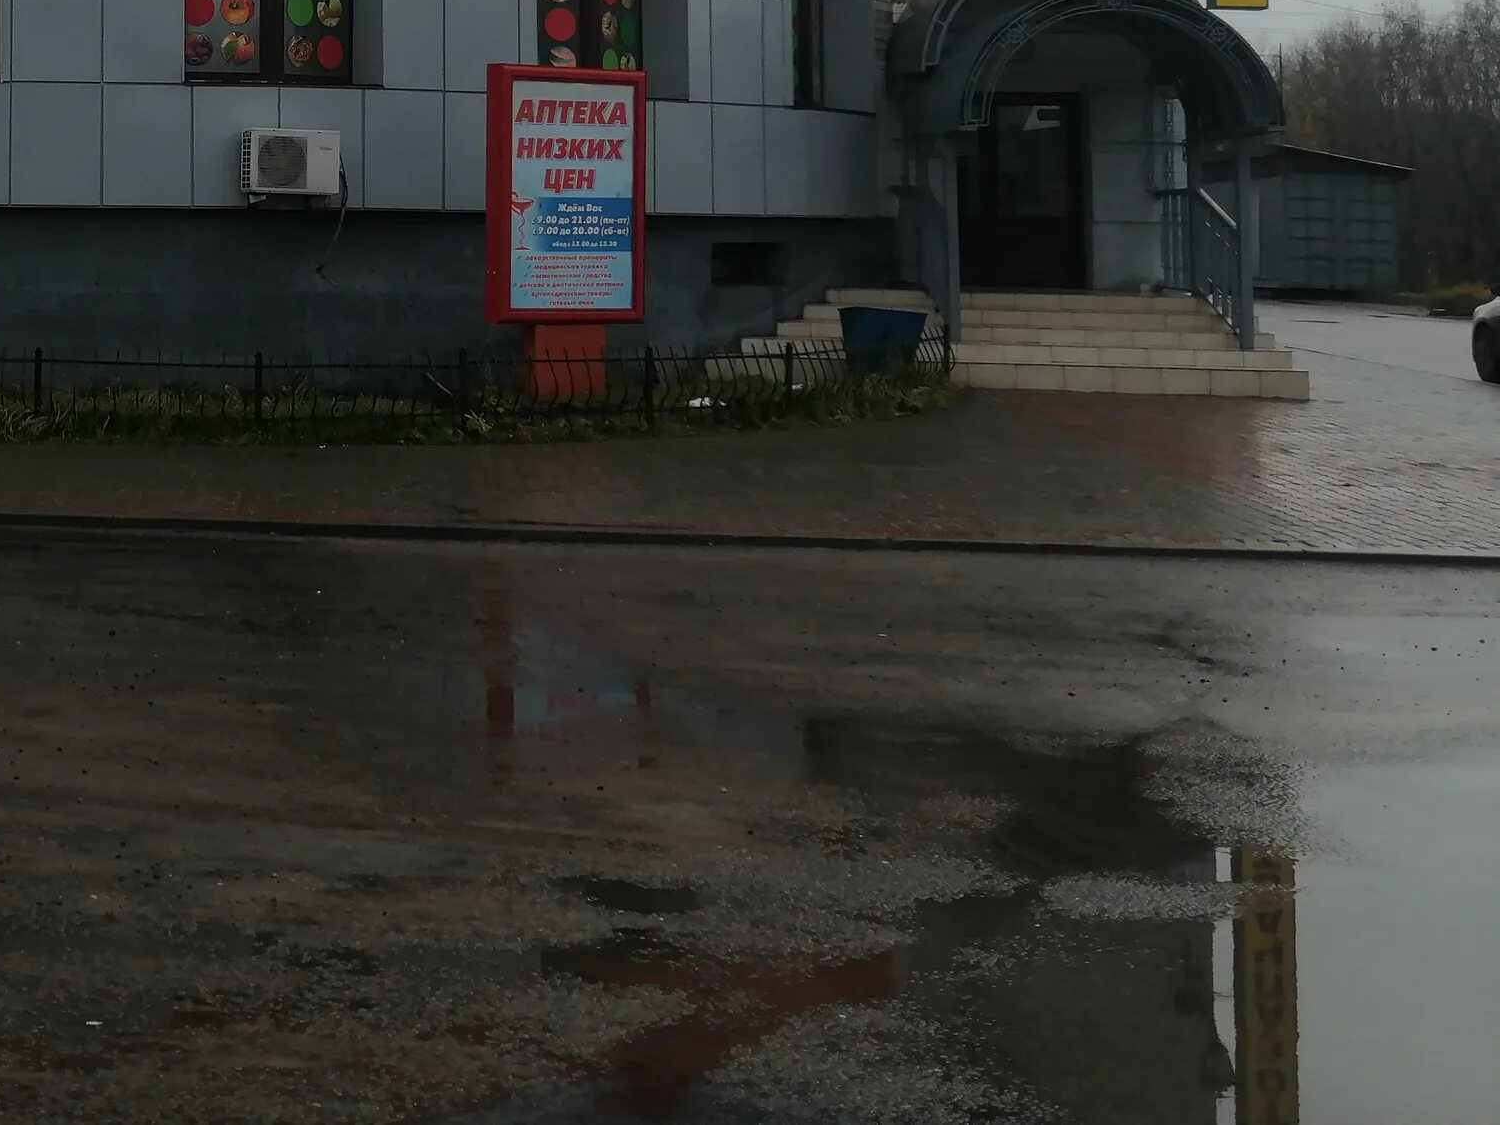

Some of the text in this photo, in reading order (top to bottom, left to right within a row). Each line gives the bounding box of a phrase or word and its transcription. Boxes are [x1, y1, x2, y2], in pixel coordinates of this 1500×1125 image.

[514, 99, 628, 125] АПТЕКА
[516, 137, 625, 161] НИЗКИХ
[542, 168, 596, 194] ЦЕН
[558, 203, 603, 213] Ждём Вас
[537, 216, 557, 224] 9.00
[558, 217, 570, 225] до
[571, 216, 598, 224] 21.00
[599, 216, 630, 226] (пн-пт)
[537, 227, 559, 235] 9.00
[559, 228, 571, 236] до
[572, 227, 600, 235] 20.00
